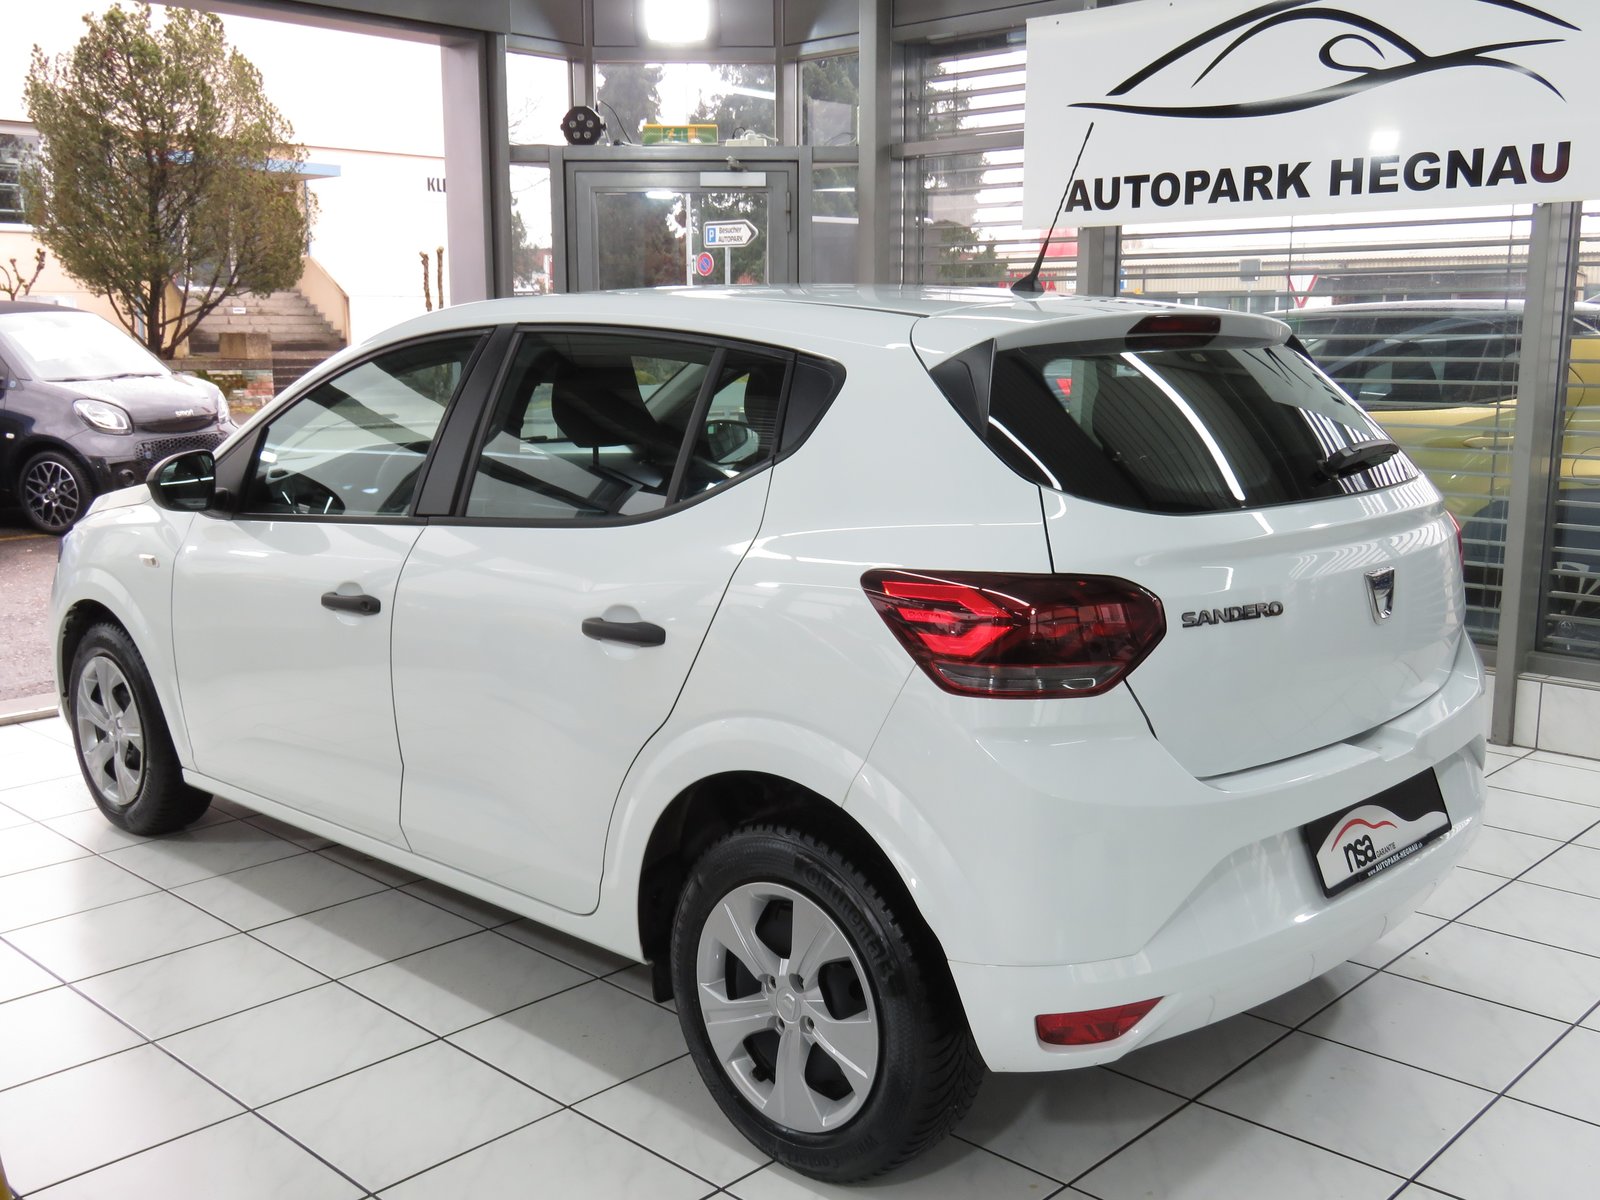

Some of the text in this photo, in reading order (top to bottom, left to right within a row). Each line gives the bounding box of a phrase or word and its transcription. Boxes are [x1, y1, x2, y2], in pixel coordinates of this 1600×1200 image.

[1064, 140, 1572, 213] AUTOPARK HEGNAU
[718, 235, 743, 243] AUTOPARK
[1181, 601, 1284, 628] SANDERO
[1343, 834, 1377, 873] nsa
